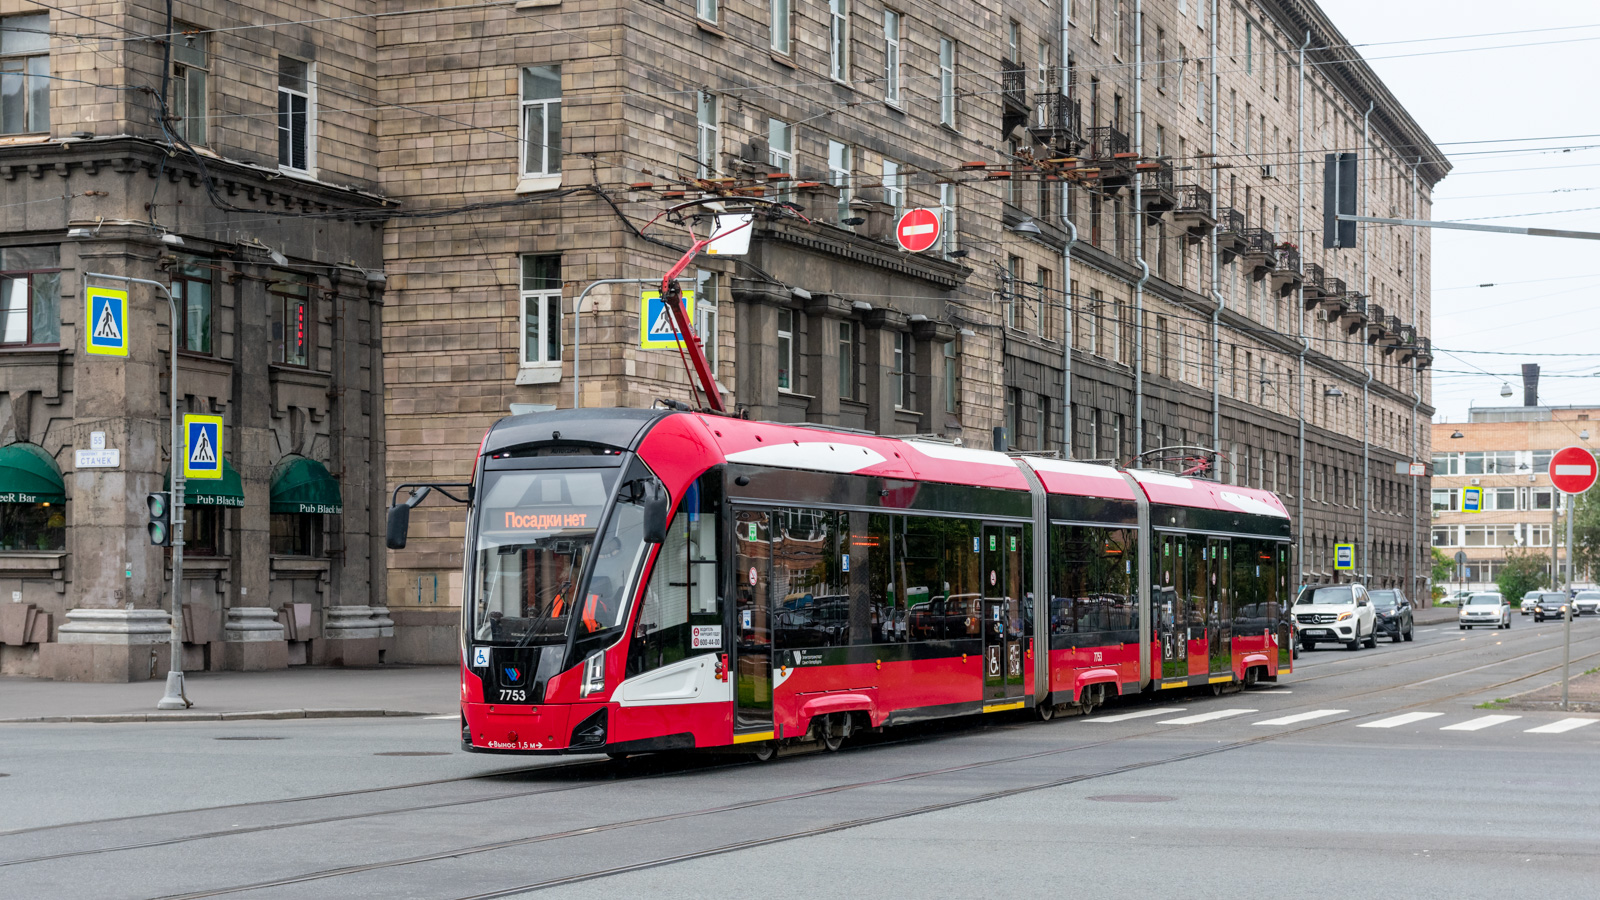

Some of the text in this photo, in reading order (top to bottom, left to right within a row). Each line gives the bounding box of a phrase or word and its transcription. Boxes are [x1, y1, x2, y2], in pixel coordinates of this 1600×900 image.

[93, 436, 103, 445] 55
[80, 457, 112, 465] СТАЧЕК
[18, 493, 37, 503] Bar
[196, 494, 215, 505] Pub
[216, 495, 236, 506] Black
[299, 503, 316, 513] Pub
[317, 504, 336, 514] Black
[505, 511, 588, 530] Посадки нет
[699, 638, 721, 646] 600-44-00
[1093, 651, 1103, 662] 7753
[499, 689, 527, 702] 7753
[493, 740, 517, 749] Вынос
[517, 741, 529, 750] 1,5
